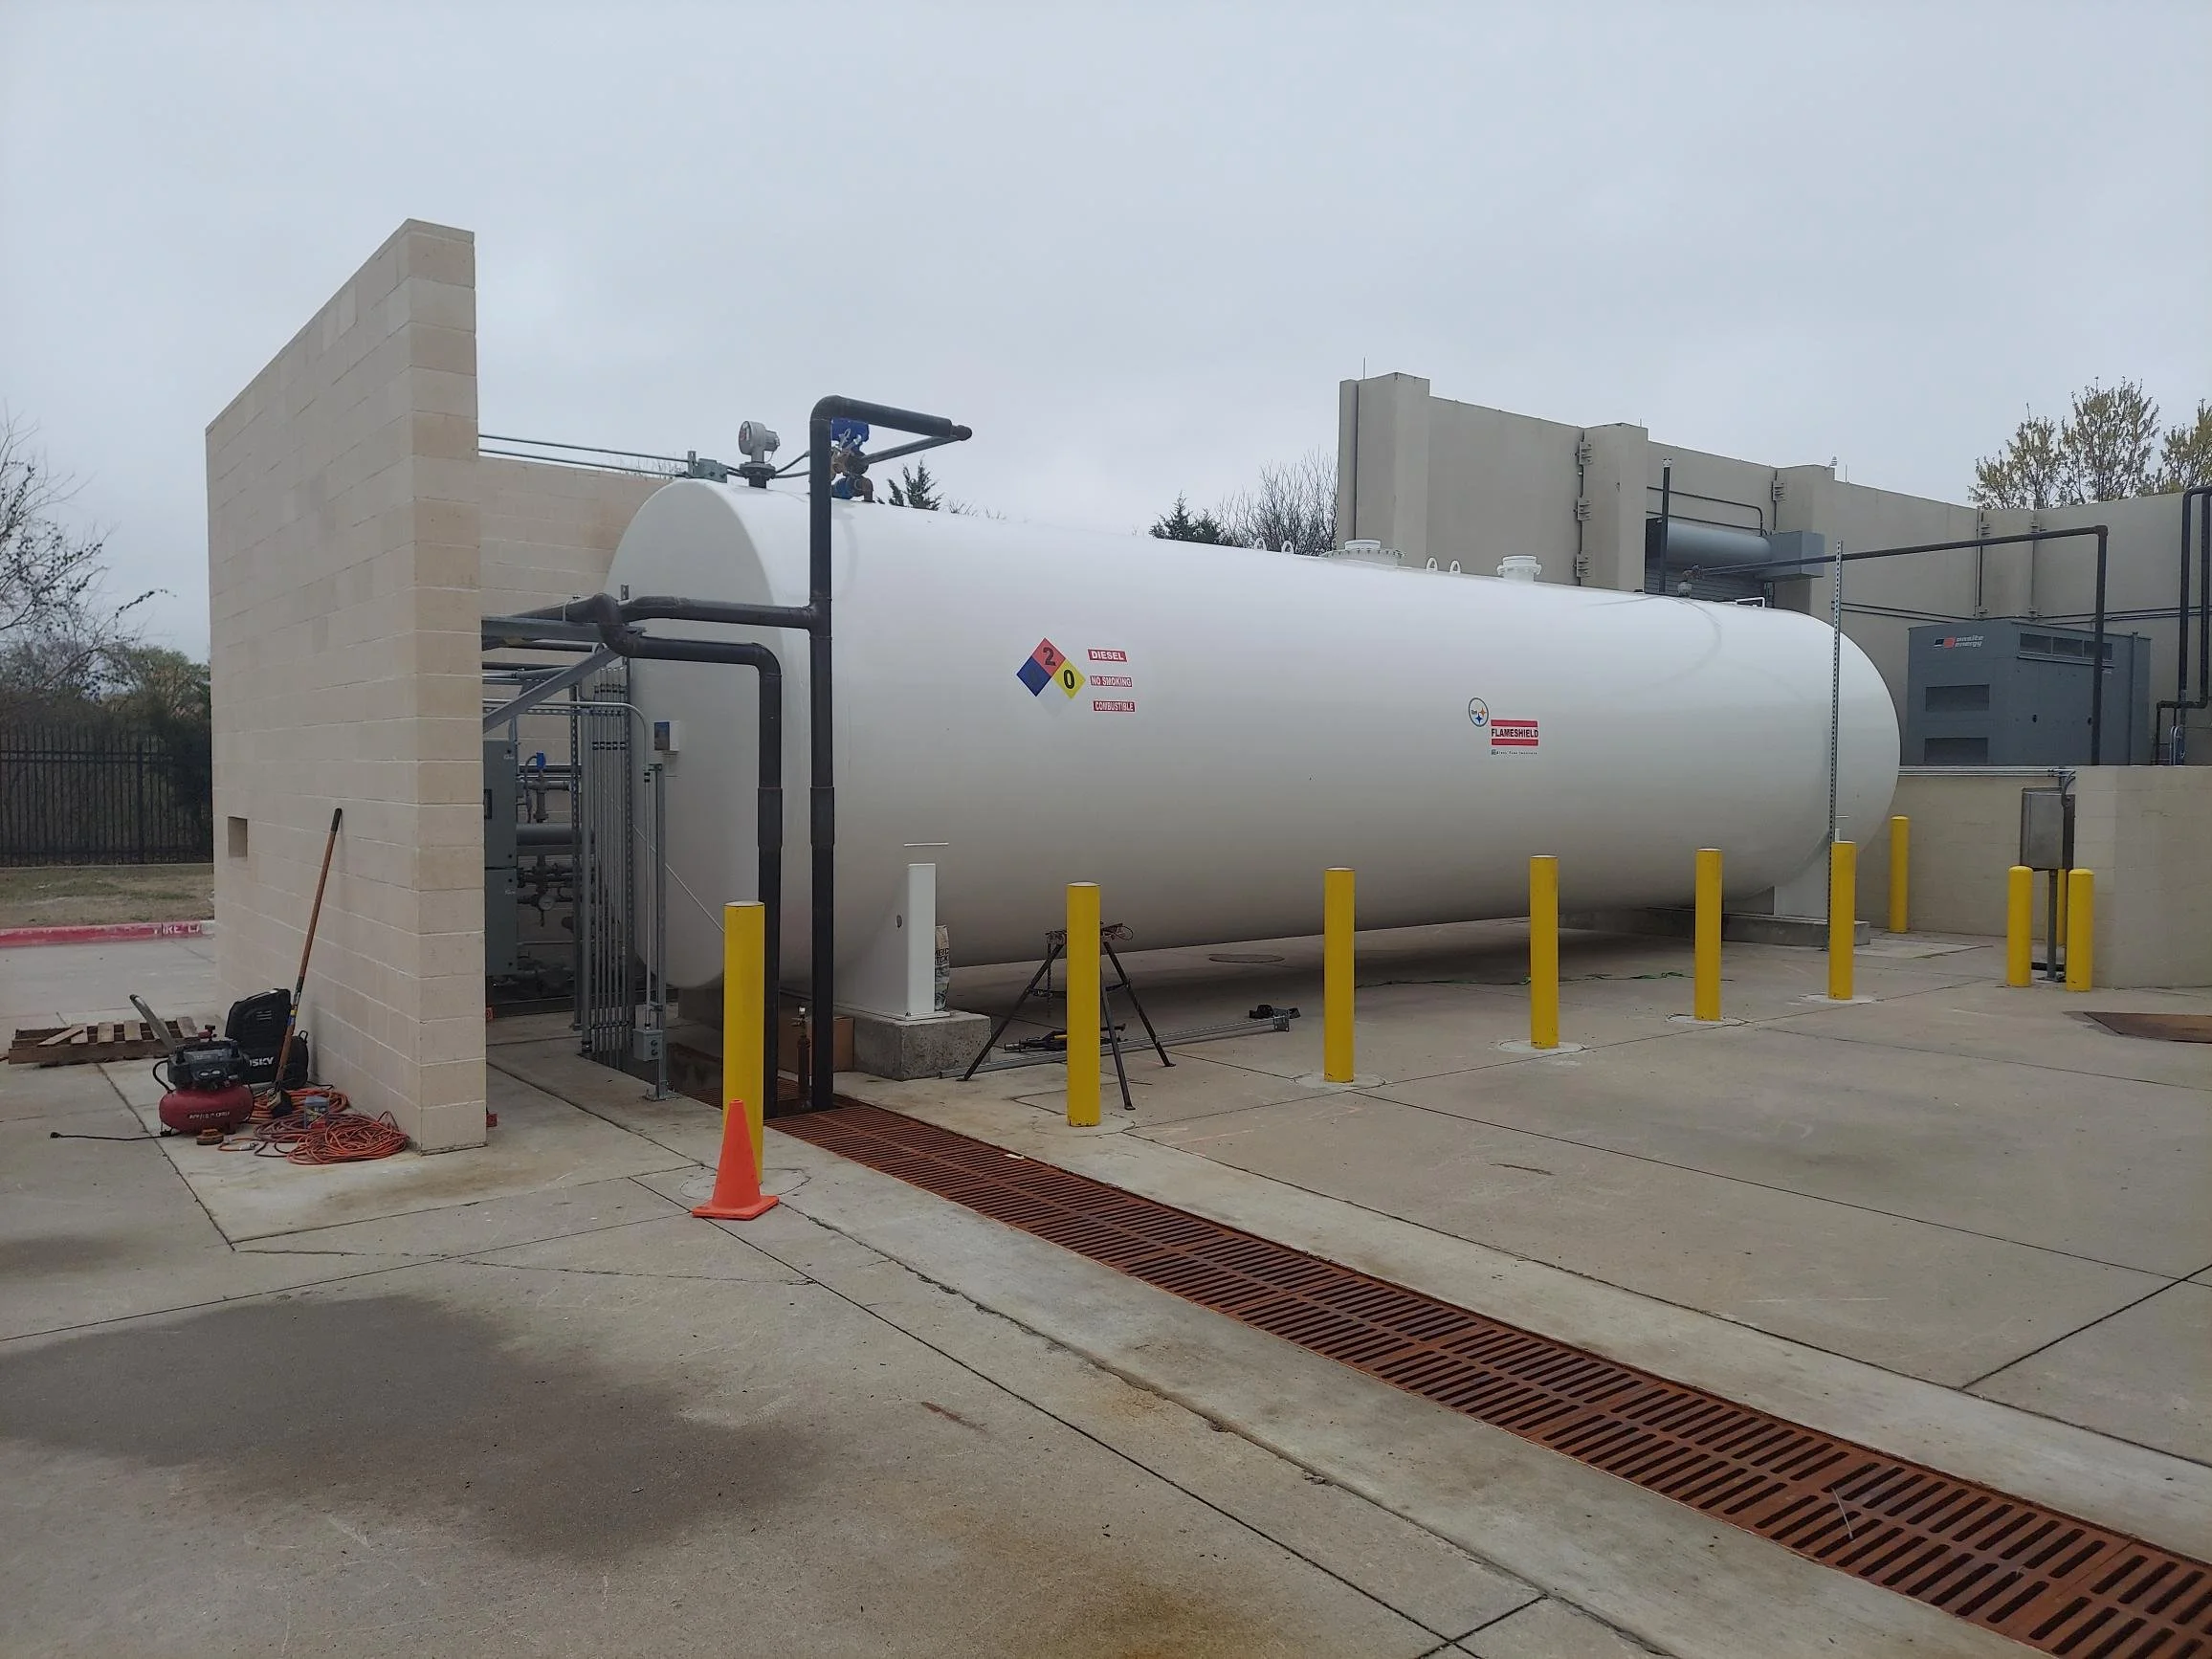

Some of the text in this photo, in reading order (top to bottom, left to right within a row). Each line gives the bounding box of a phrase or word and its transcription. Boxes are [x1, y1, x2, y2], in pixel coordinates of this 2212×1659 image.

[1042, 647, 1056, 666] 2
[1091, 651, 1124, 661] DIESEL
[1063, 669, 1075, 689] 0
[1091, 675, 1132, 687] NO SMOKING
[1095, 701, 1134, 711] COMBUSTIBLE
[1491, 728, 1539, 738] FLAMESHIELD
